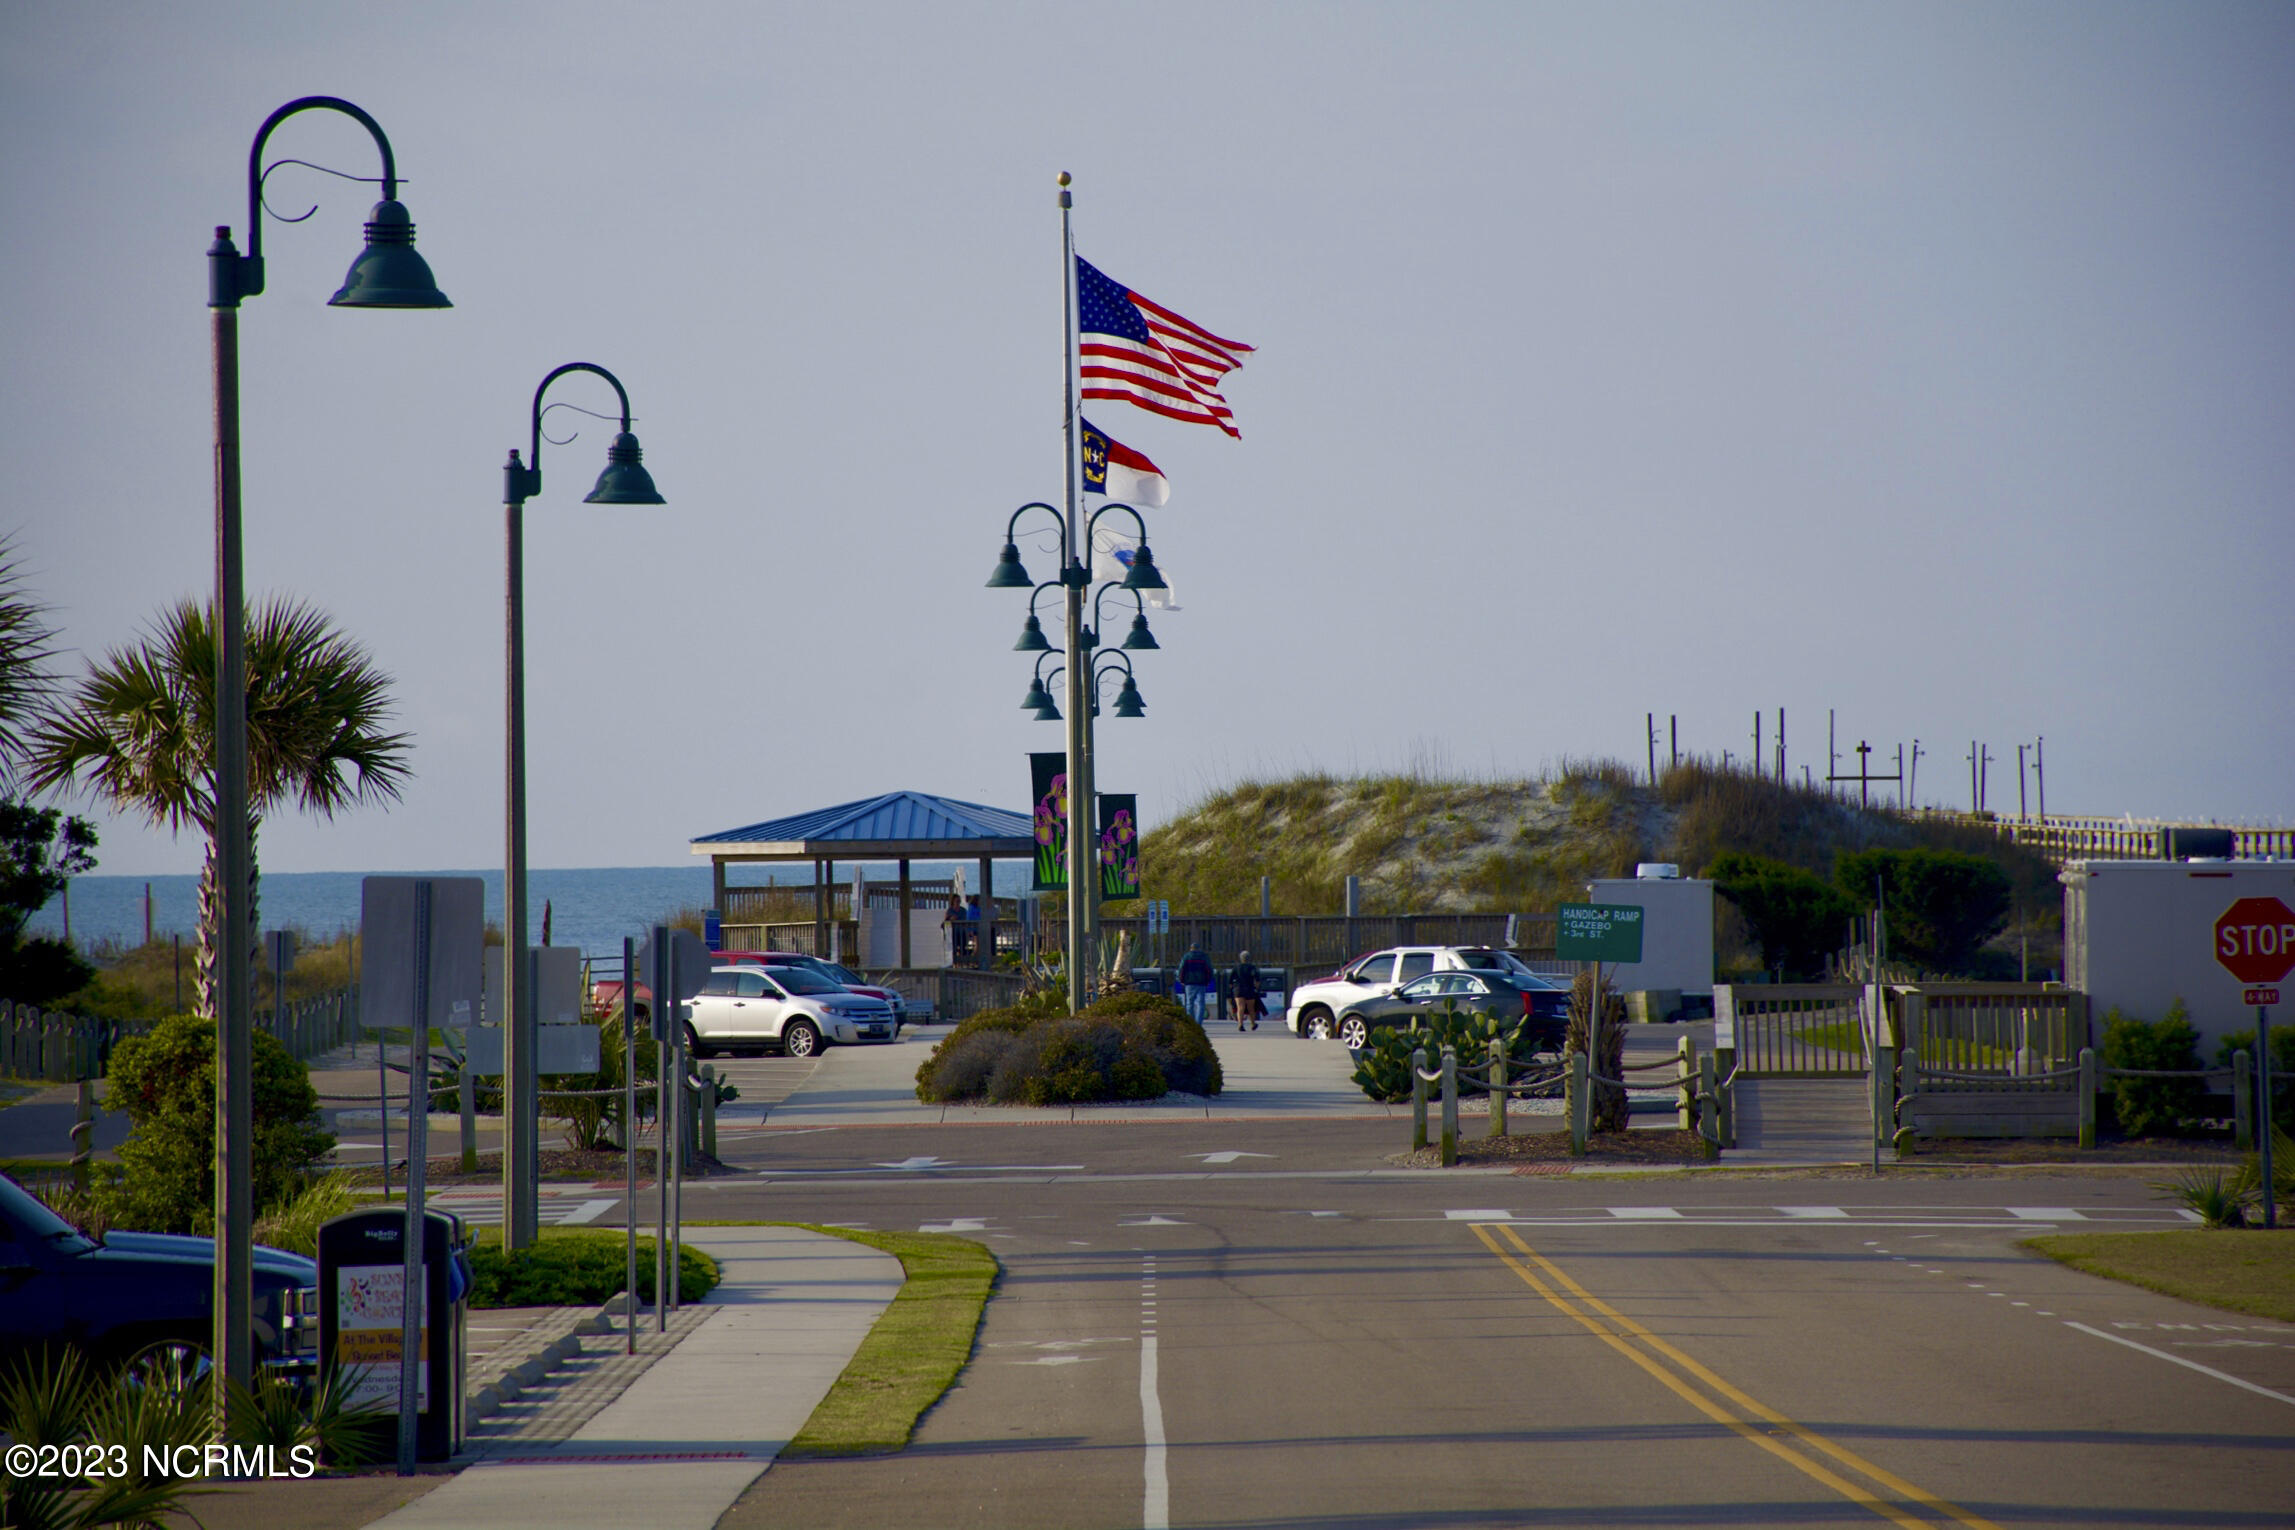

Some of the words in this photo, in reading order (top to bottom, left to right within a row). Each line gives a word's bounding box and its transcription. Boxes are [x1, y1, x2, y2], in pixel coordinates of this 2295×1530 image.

[1563, 909, 1609, 920] HANDICAP
[1613, 910, 1640, 921] RAMP
[1571, 921, 1611, 930] GAZEBO
[2222, 924, 2295, 956] STOP
